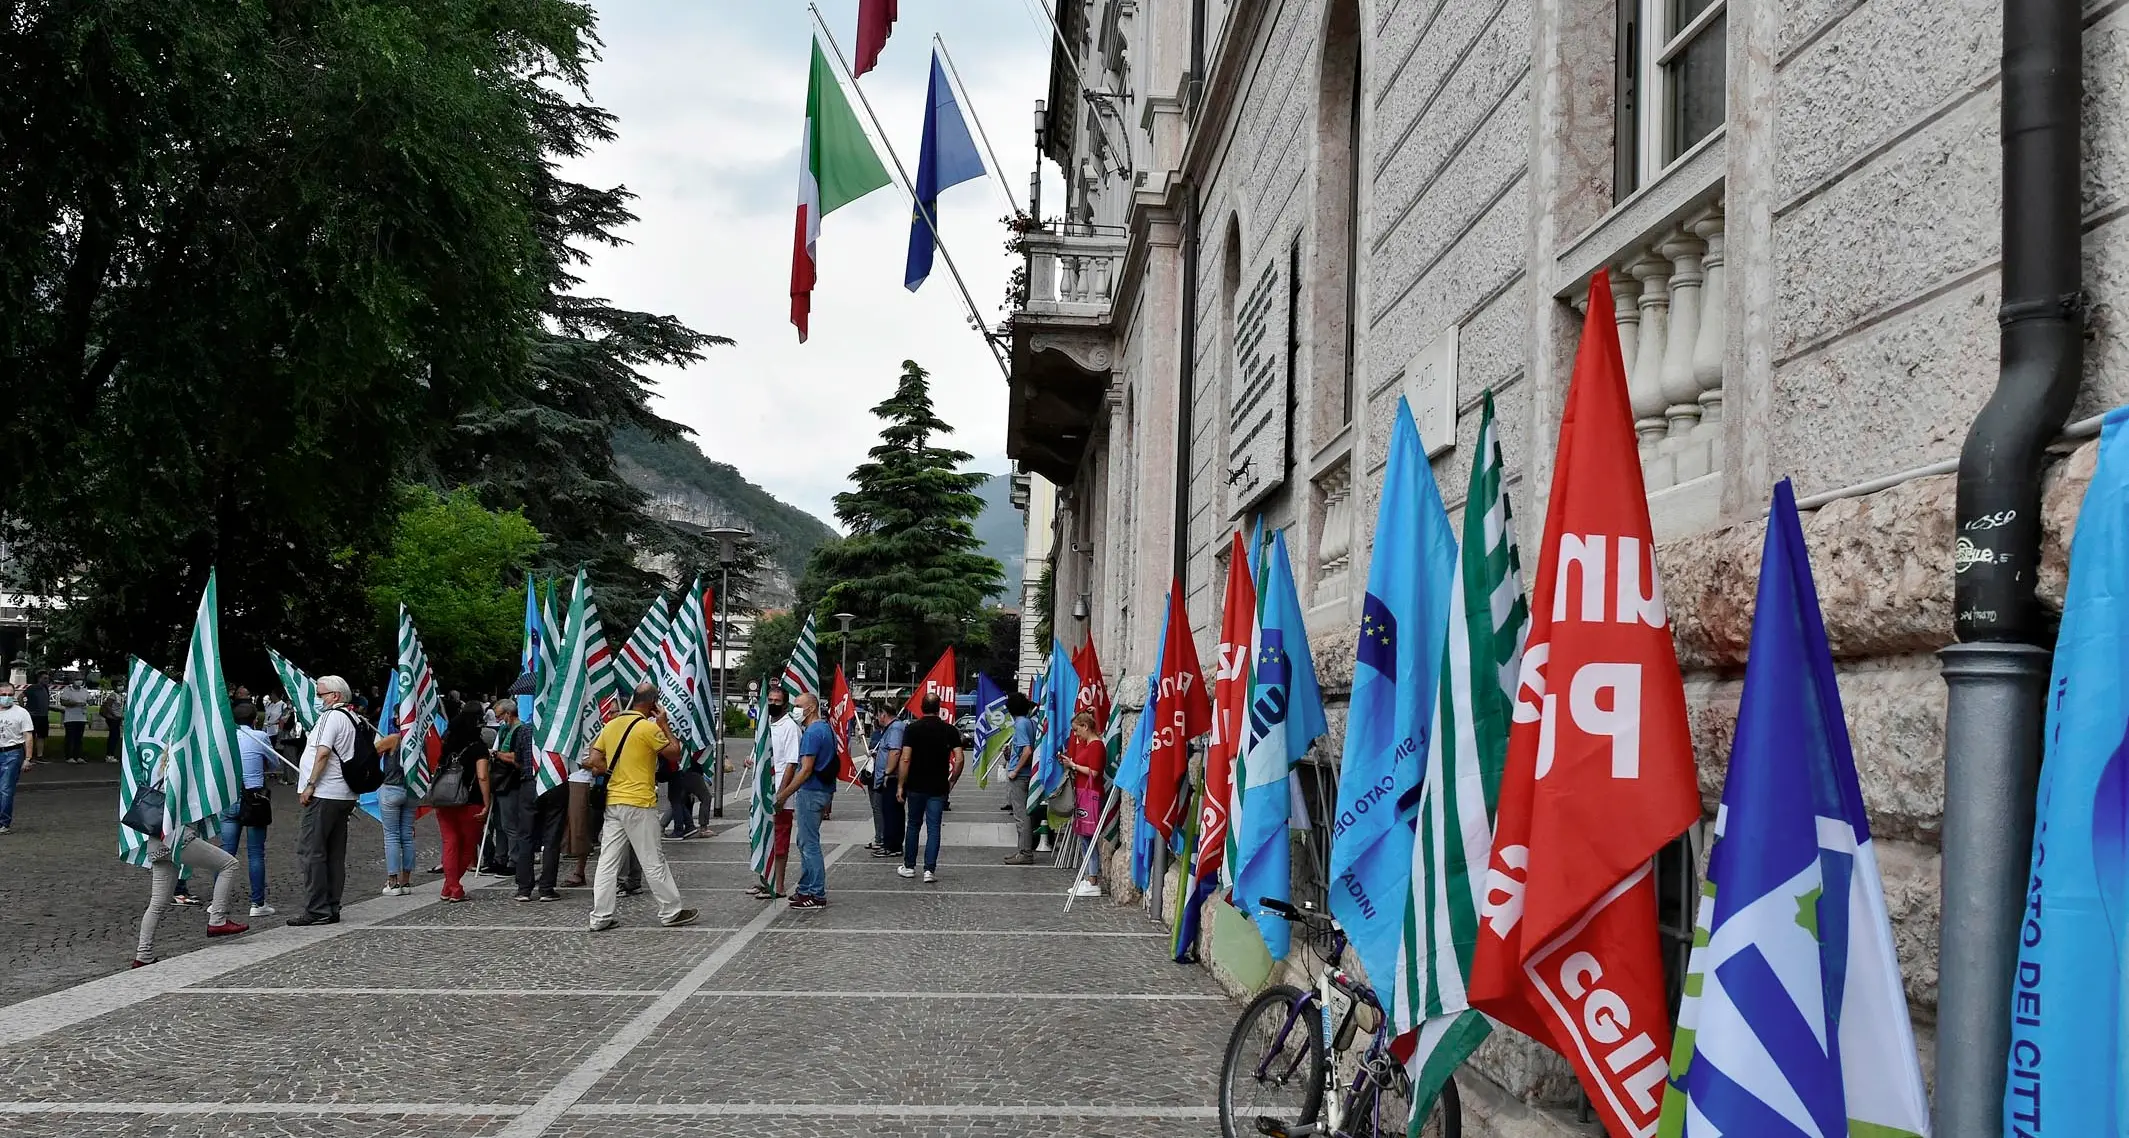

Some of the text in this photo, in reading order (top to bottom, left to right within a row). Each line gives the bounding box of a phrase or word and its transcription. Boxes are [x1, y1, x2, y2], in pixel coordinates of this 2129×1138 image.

[658, 686, 692, 738] UBBLICA
[664, 672, 695, 716] FUNZIO
[2015, 959, 2041, 1028] DEI
[1559, 950, 1670, 1116] CGIL
